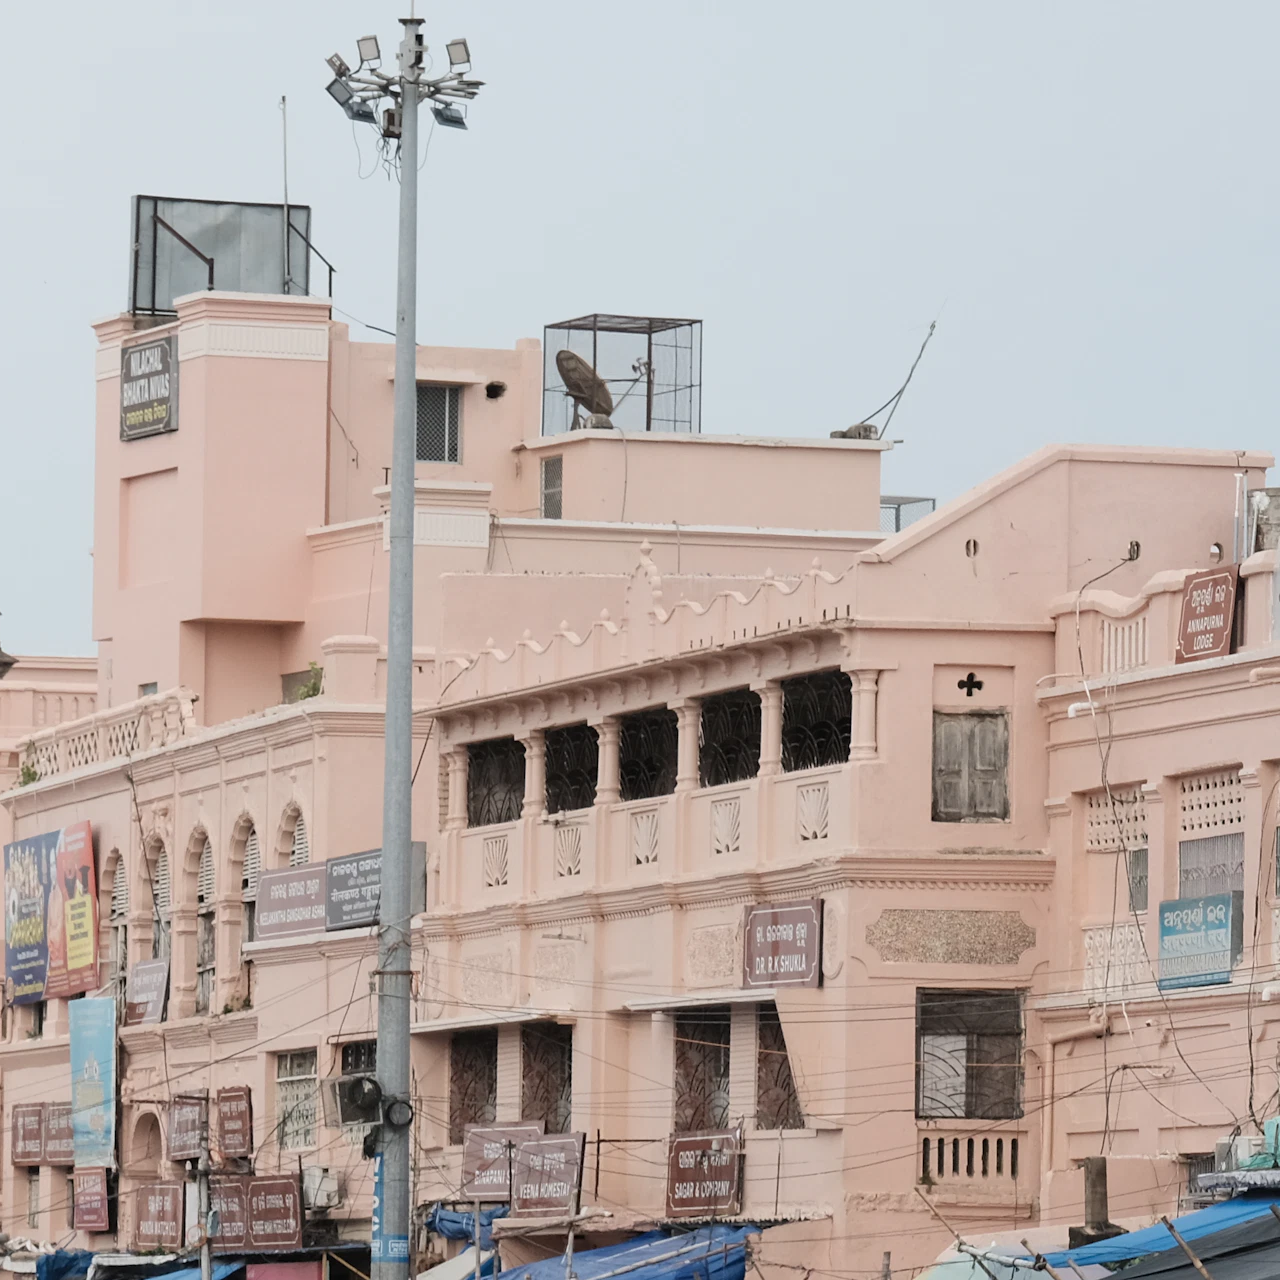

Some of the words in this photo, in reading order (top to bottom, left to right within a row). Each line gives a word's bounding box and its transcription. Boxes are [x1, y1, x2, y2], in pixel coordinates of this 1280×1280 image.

[1187, 614, 1224, 634] ANNAPURNA
[1193, 633, 1214, 650] LODGE
[756, 956, 767, 974] DR.
[780, 953, 807, 973] SHUKLA
[520, 1184, 539, 1198] VEENA
[541, 1182, 571, 1197] HOMESTAY
[675, 1182, 694, 1199] SAGAR
[695, 1182, 700, 1198] &
[701, 1181, 730, 1198] COMPANY
